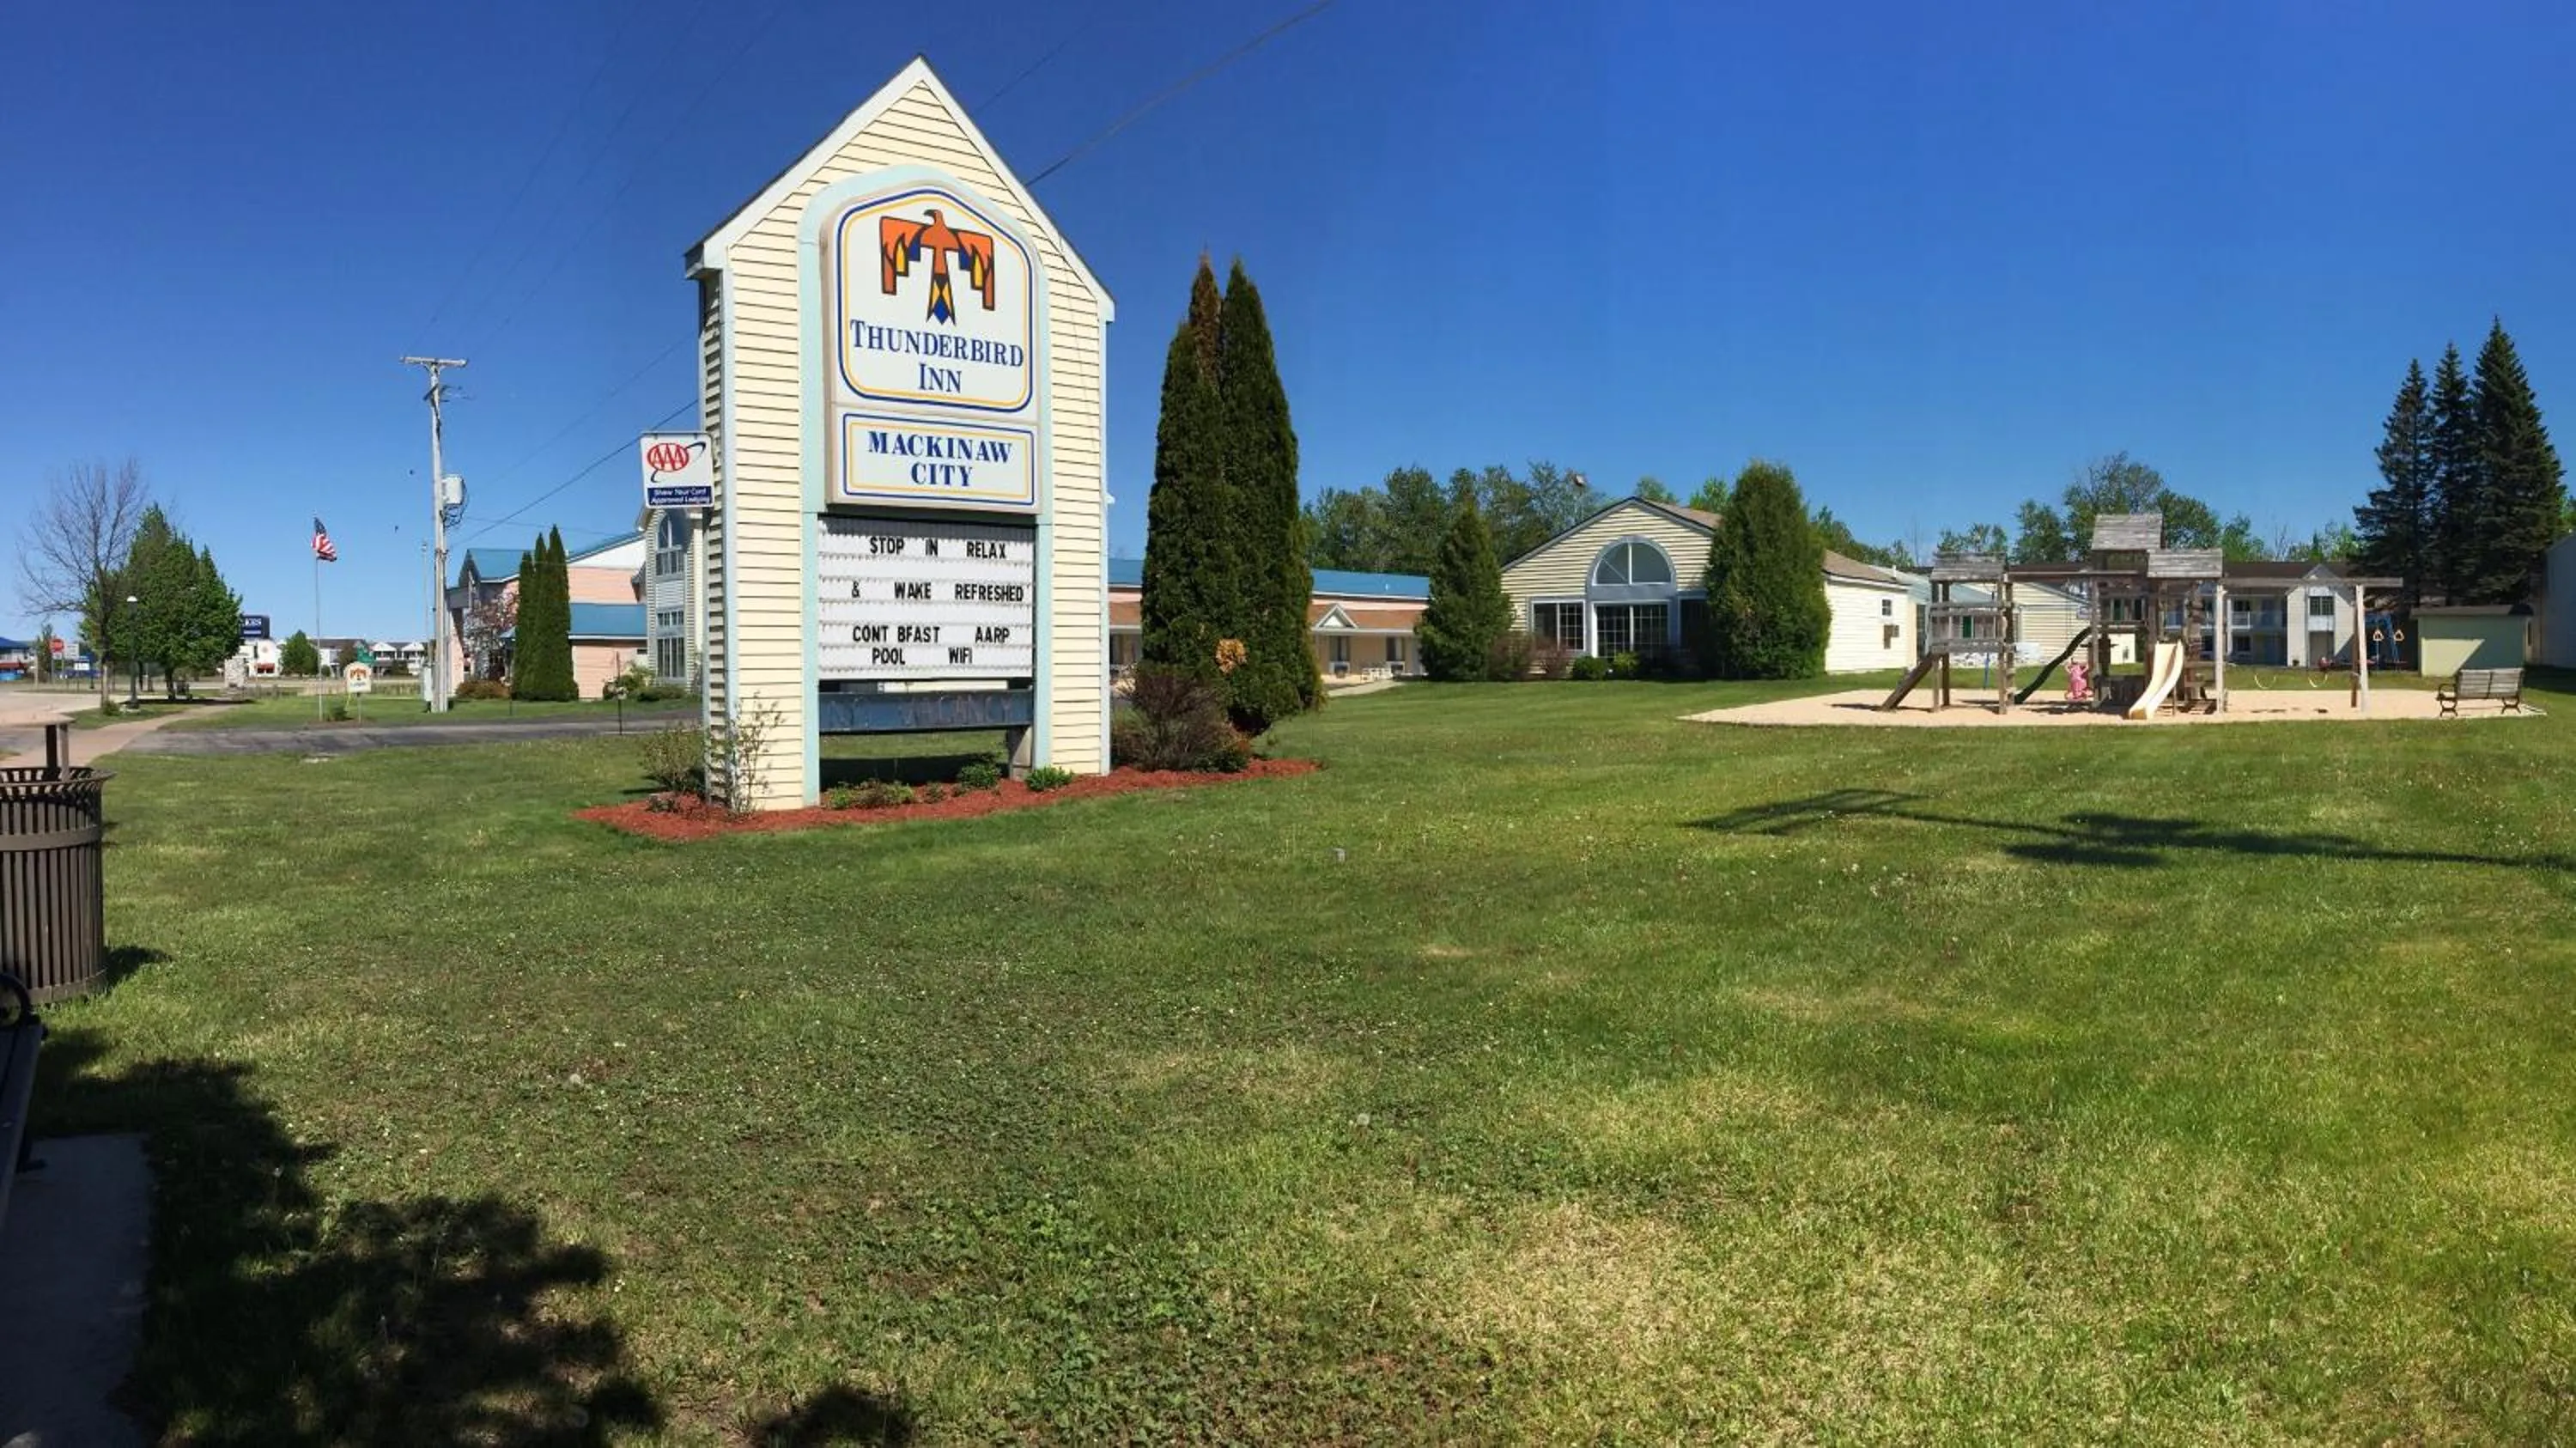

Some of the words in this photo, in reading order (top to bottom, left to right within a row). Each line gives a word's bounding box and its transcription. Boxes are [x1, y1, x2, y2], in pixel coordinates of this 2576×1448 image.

[849, 319, 1024, 368] THUNDERBIRD
[918, 363, 963, 394] INN
[651, 444, 686, 471] AAA
[868, 431, 1012, 464] MACKINAW
[910, 464, 974, 487] CITY
[870, 537, 905, 555] STOP
[925, 538, 939, 557] IN
[966, 540, 1007, 560] RELAX
[851, 581, 860, 599] &
[894, 581, 932, 600] WAKE
[955, 583, 1024, 602] REFRESHED
[853, 625, 889, 643] CONT
[897, 626, 940, 644] BFAST
[975, 627, 1010, 644] AARP
[872, 647, 906, 666] POOL
[948, 647, 973, 664] WIFI
